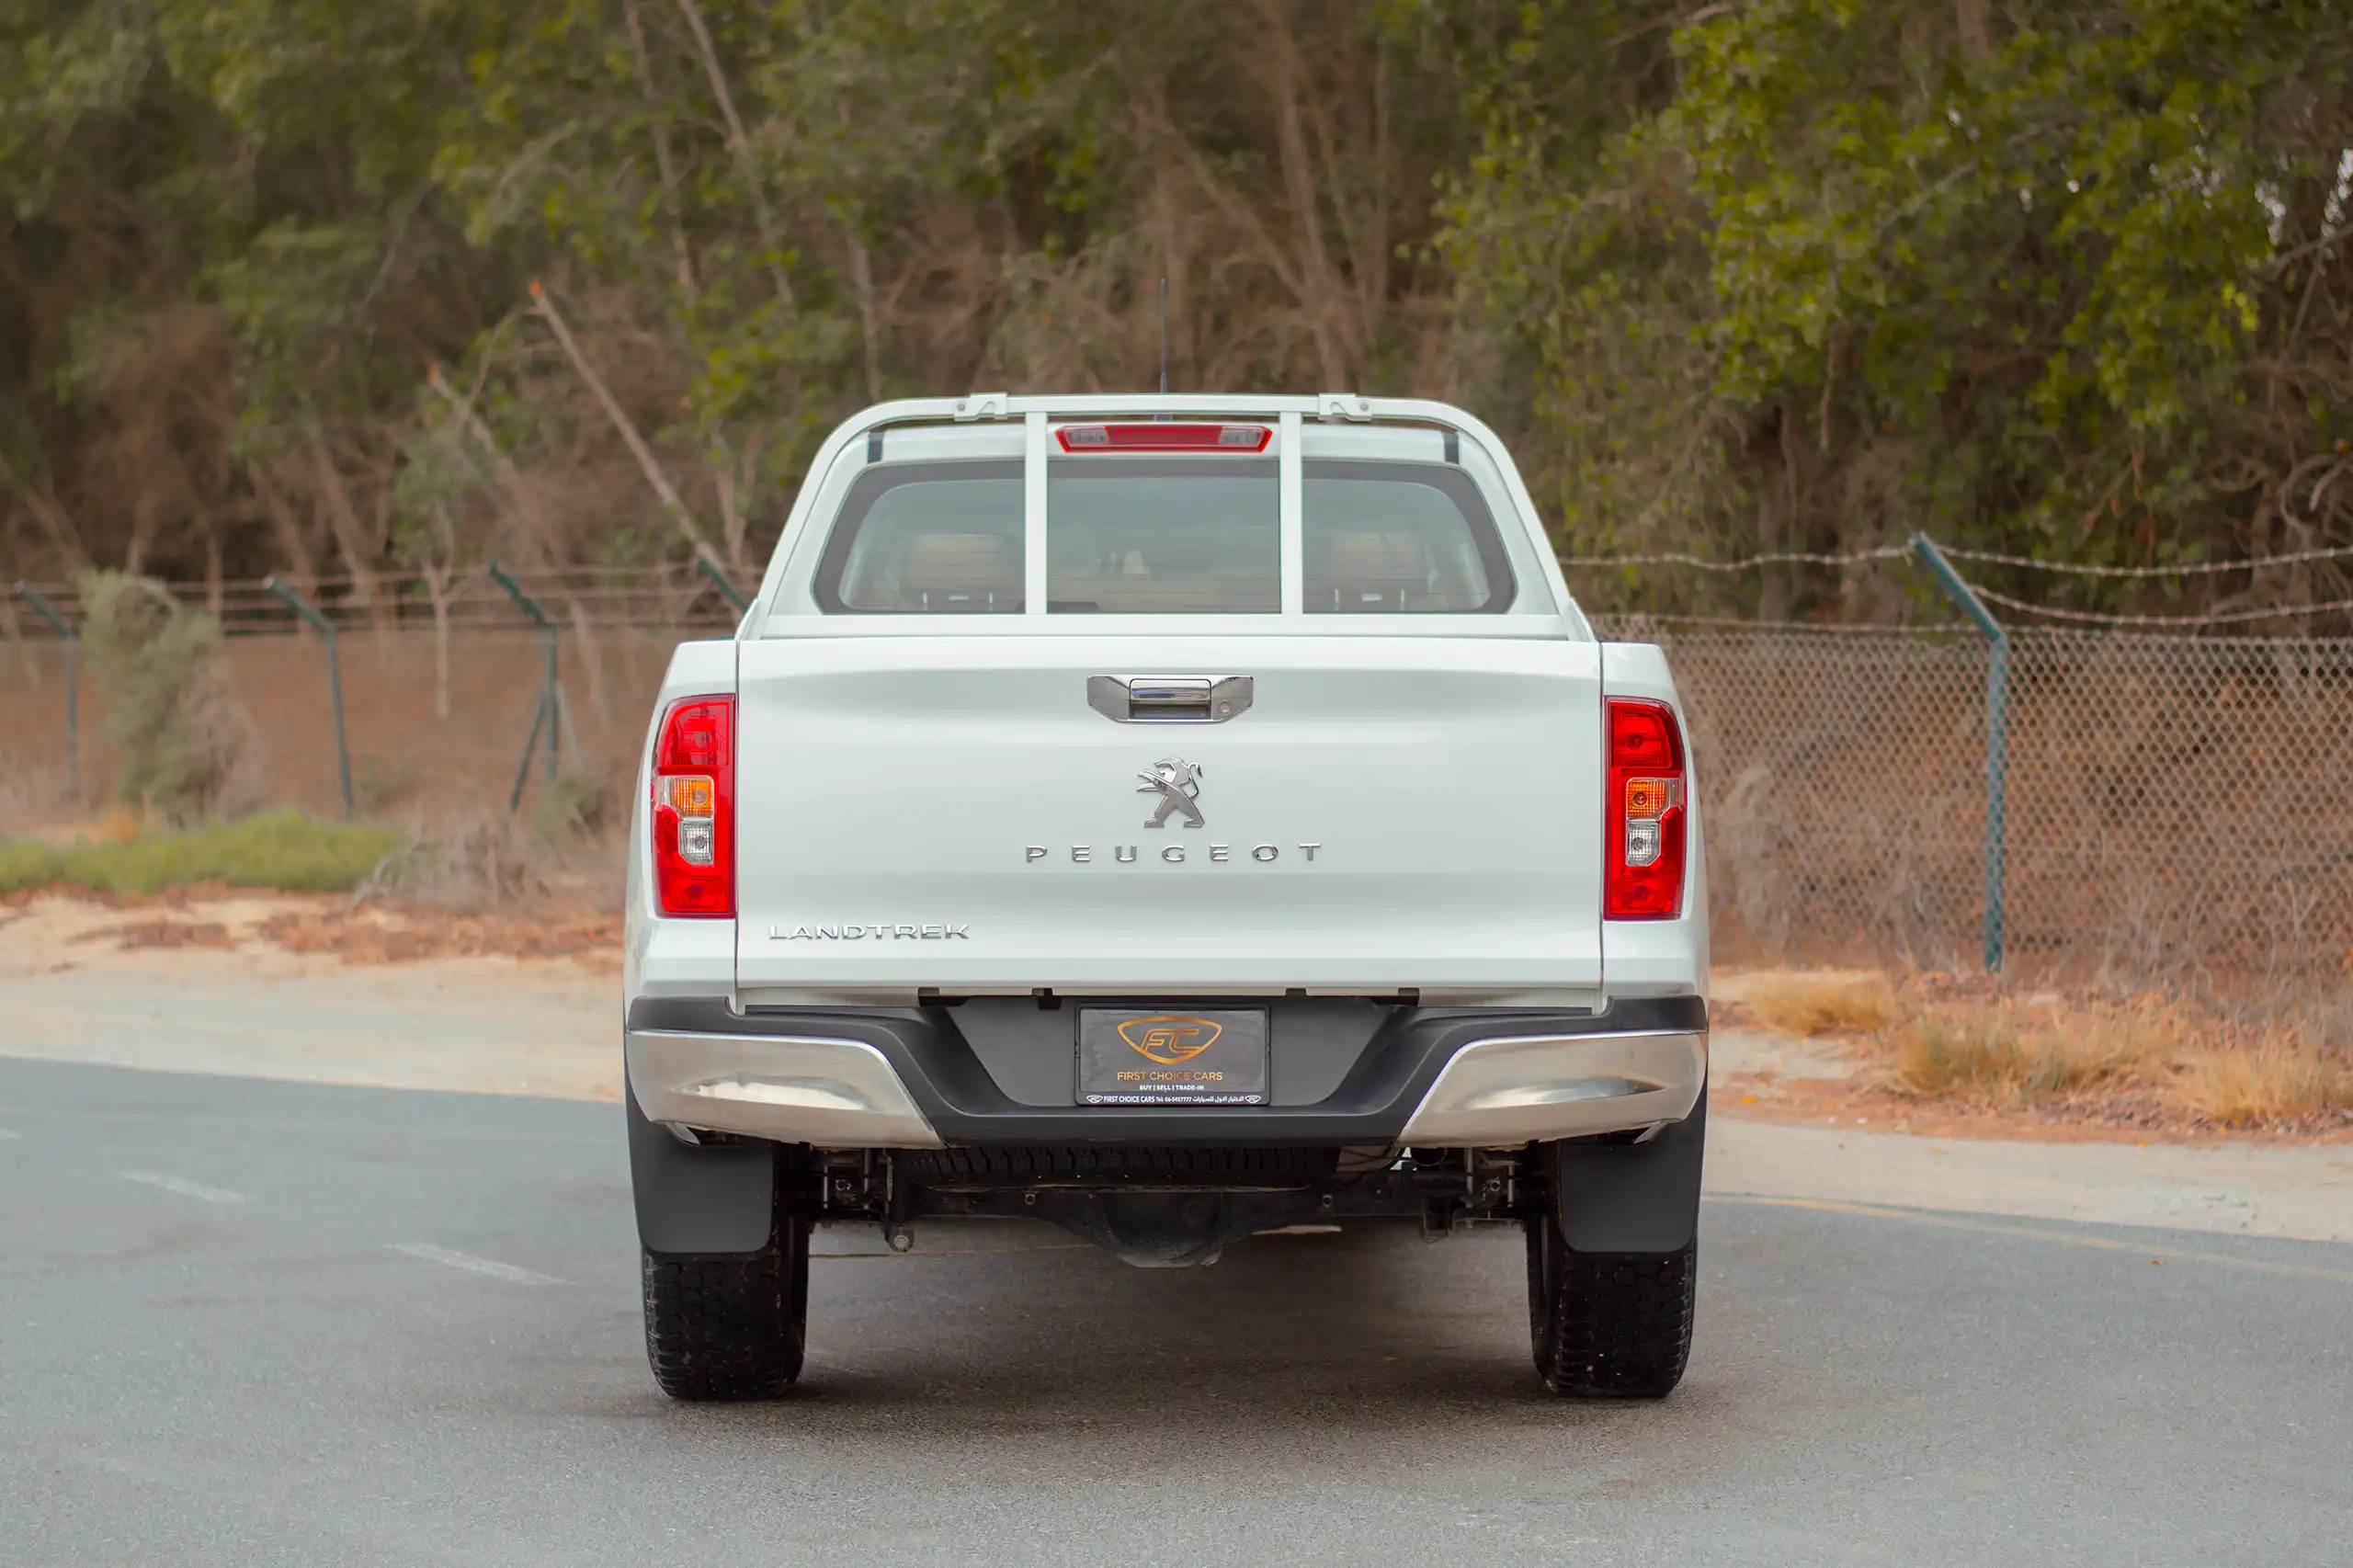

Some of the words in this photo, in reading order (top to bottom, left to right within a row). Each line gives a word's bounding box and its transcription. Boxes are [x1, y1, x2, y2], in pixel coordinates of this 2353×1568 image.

[1026, 843, 1321, 863] PEUGEOT
[768, 923, 971, 940] LANDTREK
[1117, 1071, 1146, 1081] FIRST
[1149, 1071, 1191, 1081] CHOICE
[1193, 1071, 1222, 1081] CARS
